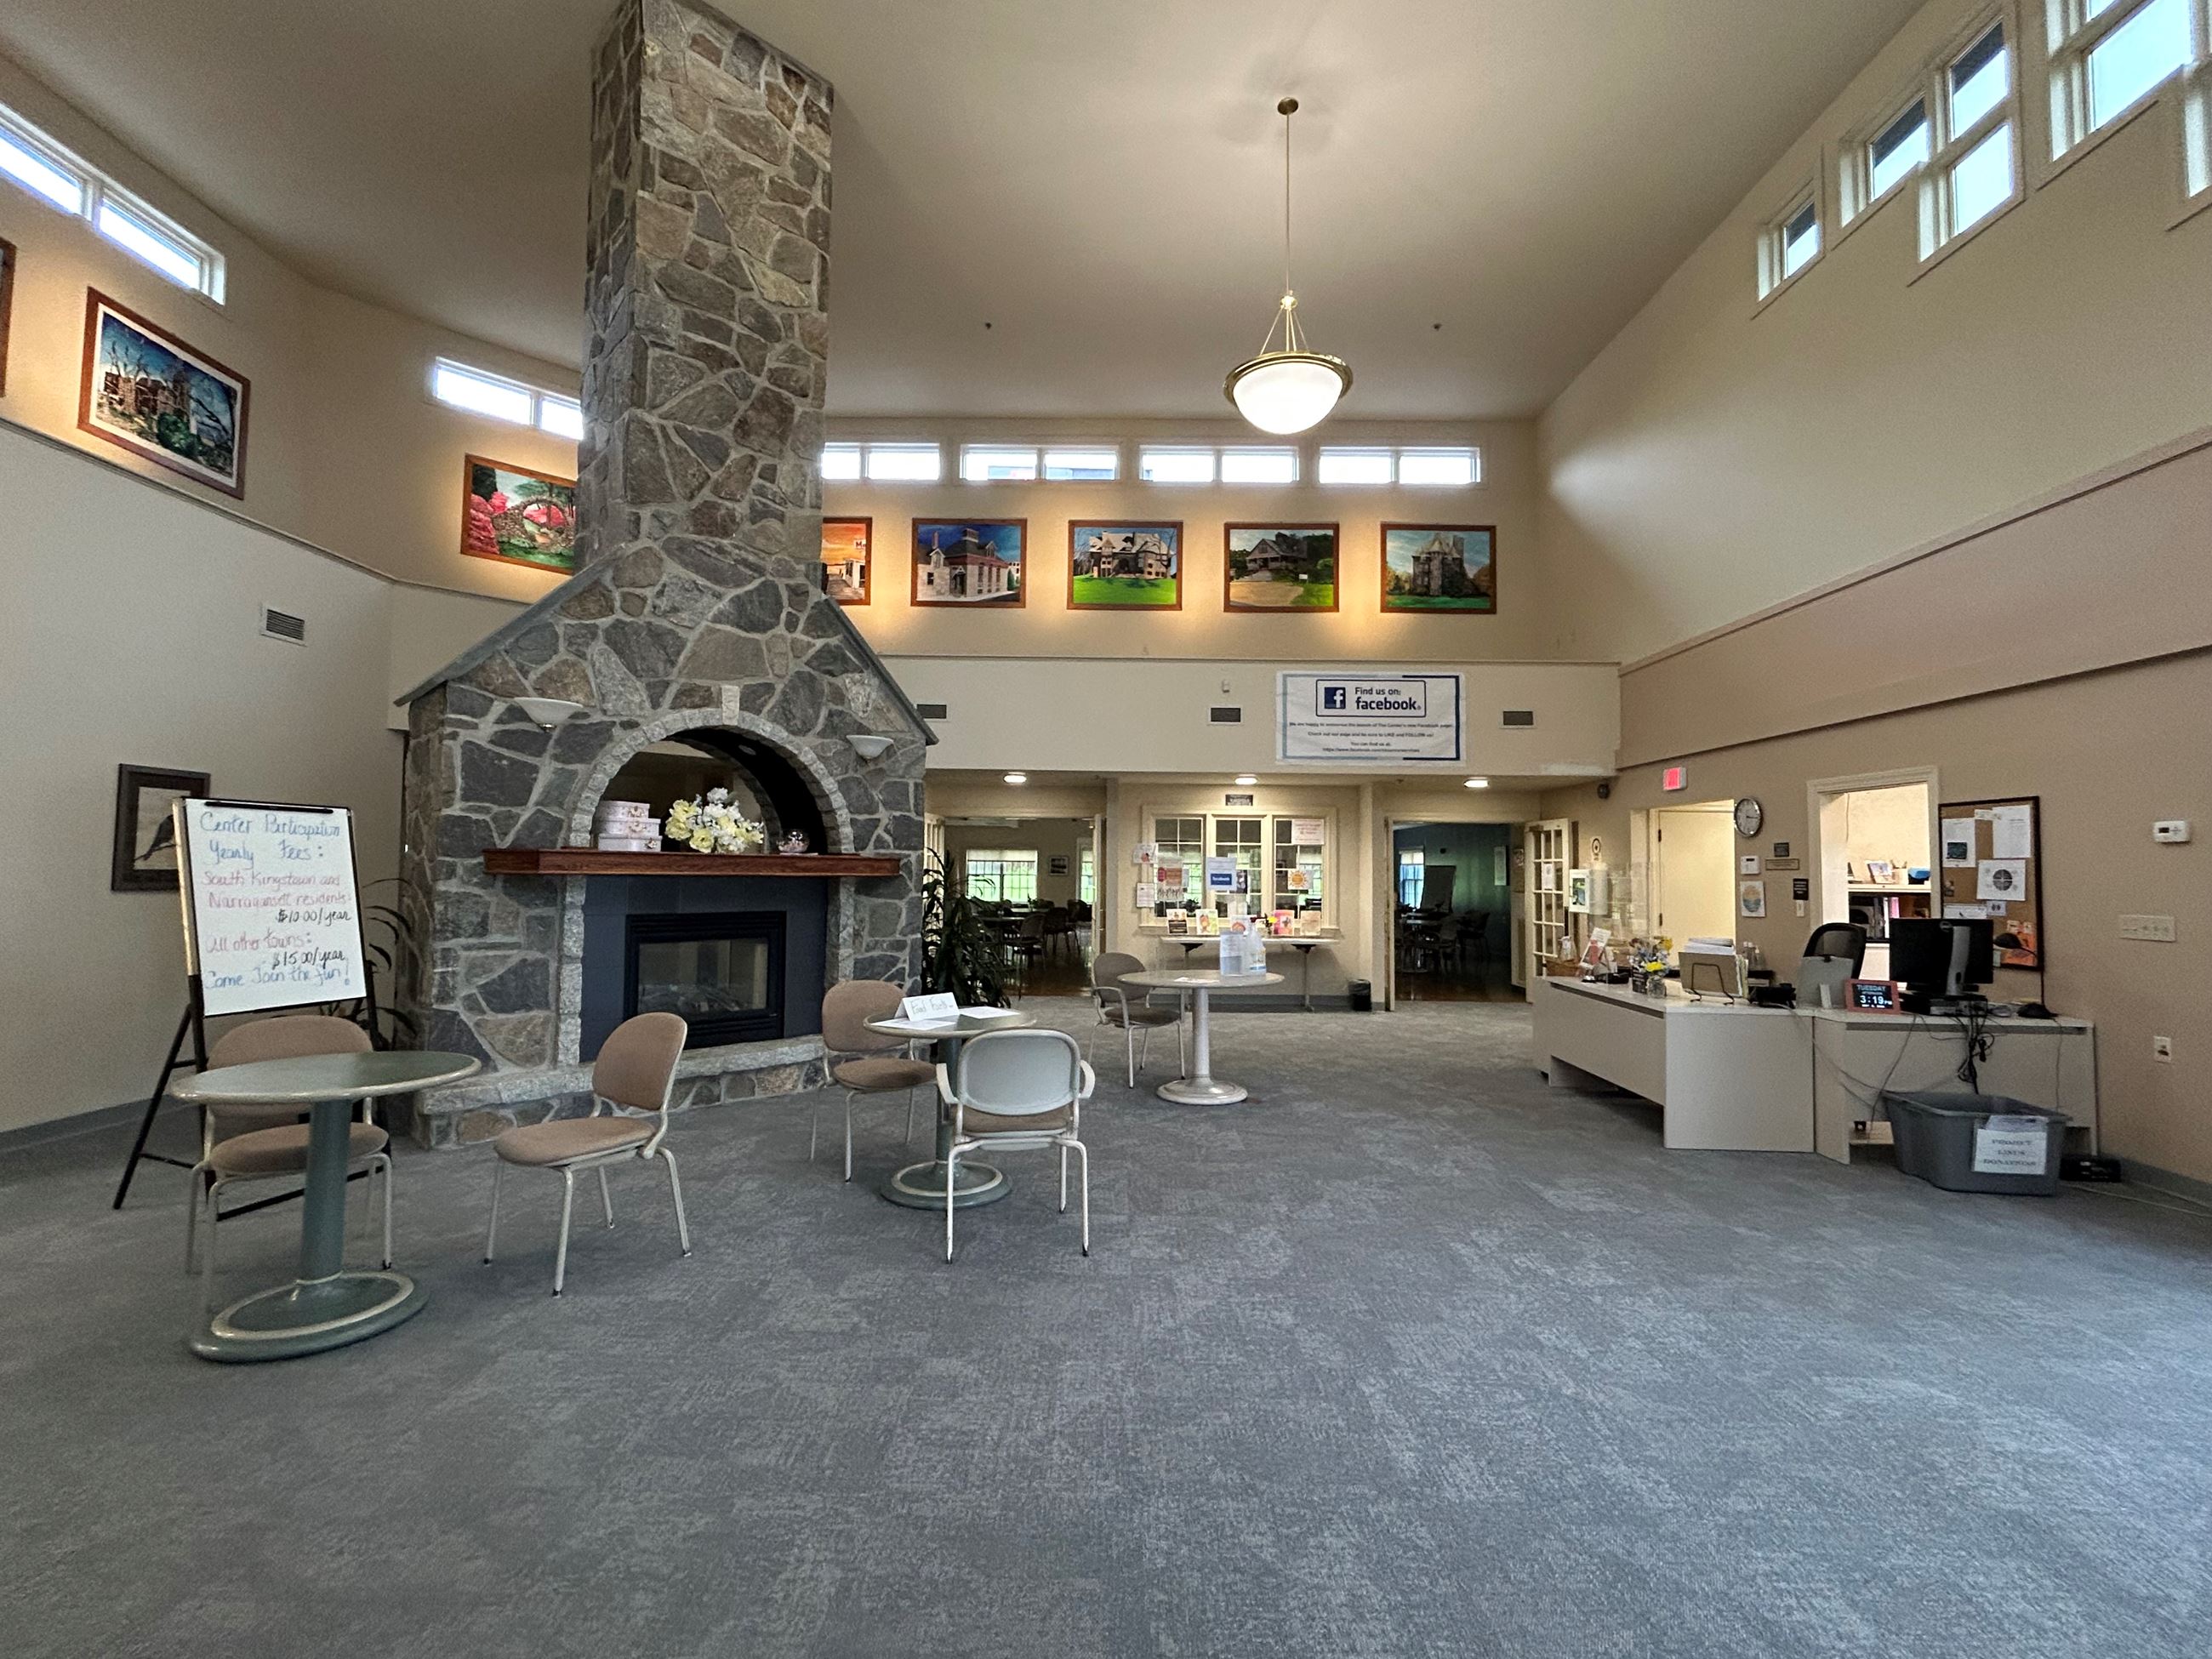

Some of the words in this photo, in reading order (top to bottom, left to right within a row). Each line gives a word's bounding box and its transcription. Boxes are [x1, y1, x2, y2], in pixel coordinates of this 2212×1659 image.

[1355, 687, 1373, 695] Find
[1355, 696, 1417, 710] facebook
[201, 812, 252, 834] Center
[208, 840, 254, 869] Yearly
[203, 869, 244, 886] South
[252, 870, 316, 892] Kingstown
[320, 874, 340, 886] and
[233, 931, 259, 950] other
[205, 970, 245, 989] Come
[288, 964, 310, 982] the
[1860, 995, 1884, 1004] 3:19
